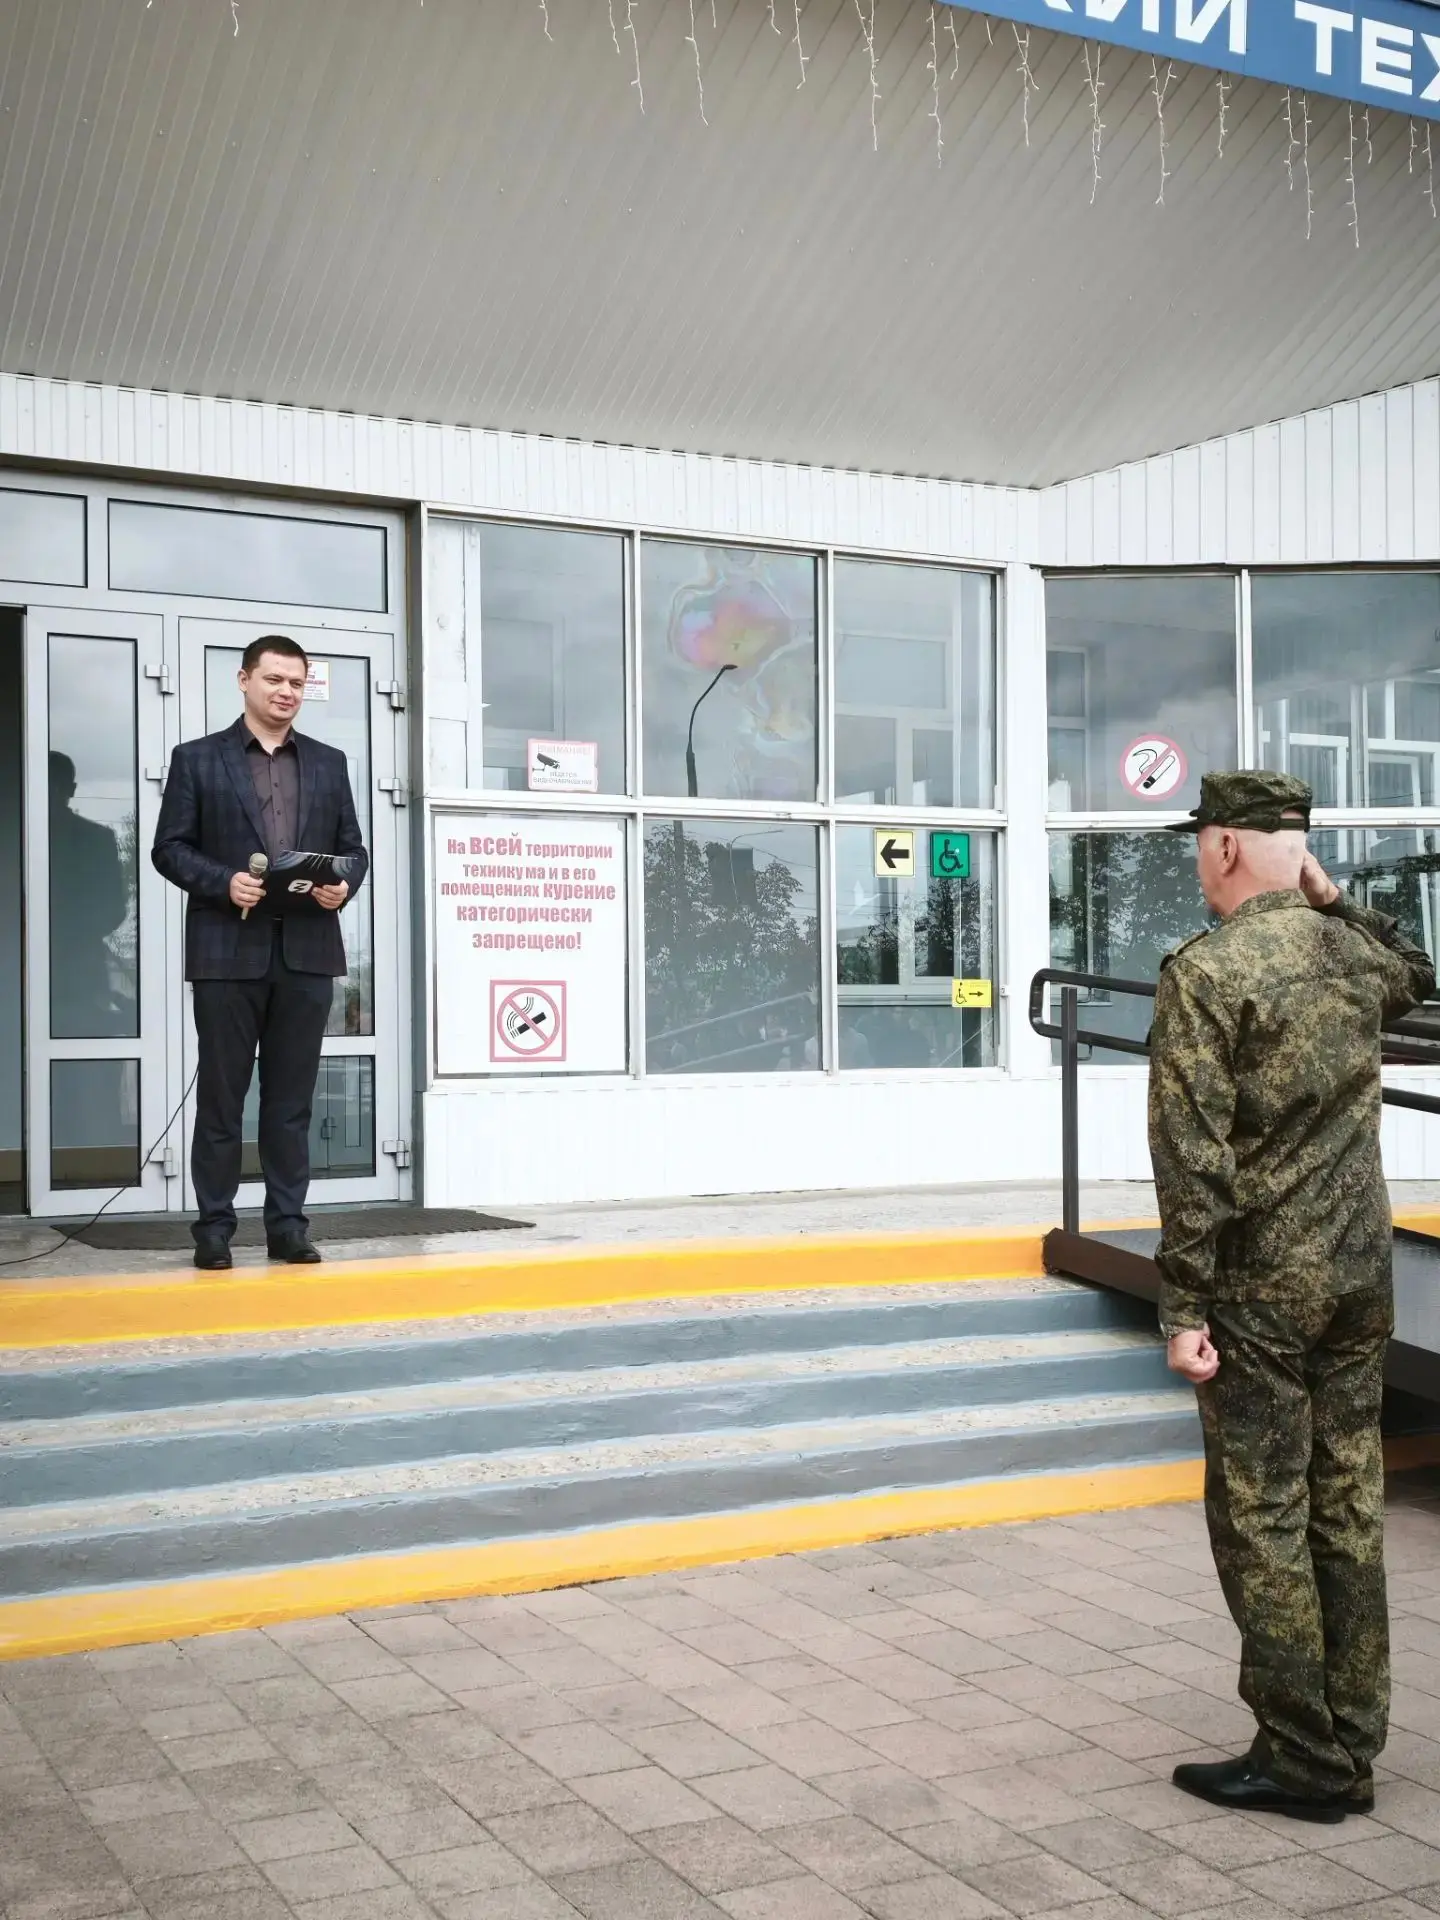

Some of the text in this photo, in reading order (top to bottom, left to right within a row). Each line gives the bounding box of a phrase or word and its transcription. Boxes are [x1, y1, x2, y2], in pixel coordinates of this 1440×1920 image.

[525, 843, 613, 860] территории
[549, 867, 558, 880] и
[562, 867, 570, 880] в
[573, 867, 597, 881] его
[441, 882, 540, 898] помещениях
[456, 905, 593, 924] категорически
[472, 931, 582, 952] запрещено!
